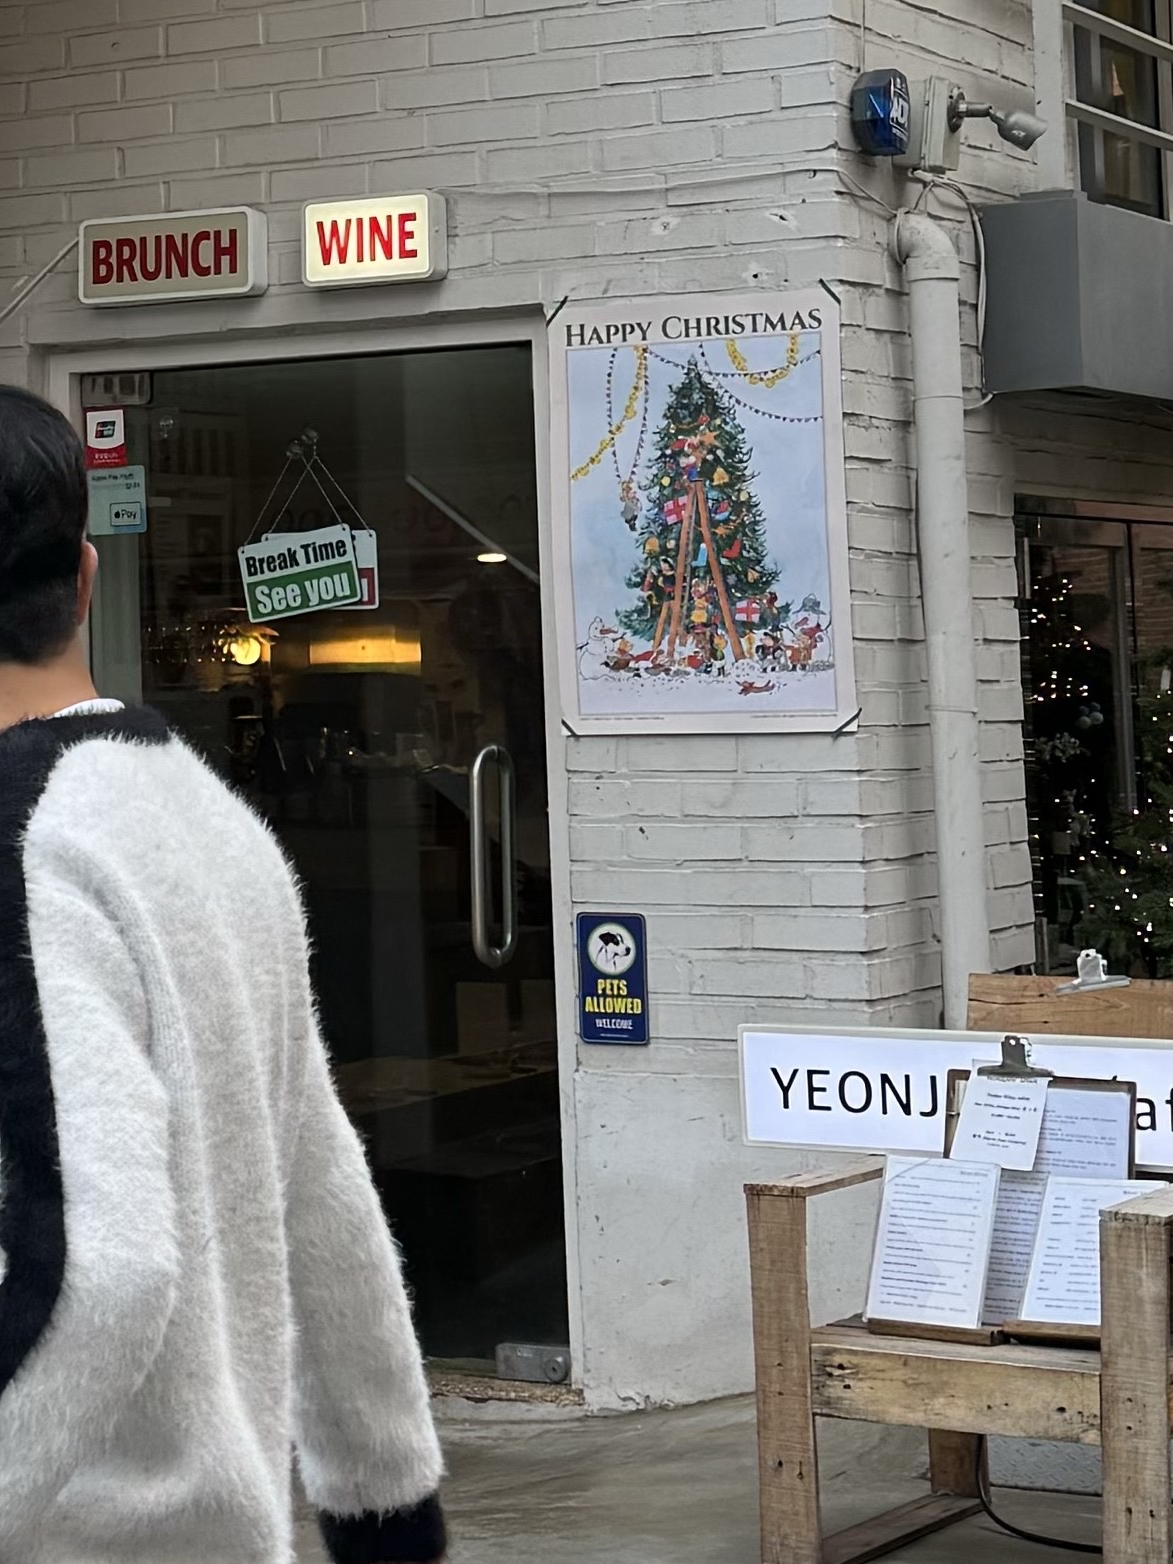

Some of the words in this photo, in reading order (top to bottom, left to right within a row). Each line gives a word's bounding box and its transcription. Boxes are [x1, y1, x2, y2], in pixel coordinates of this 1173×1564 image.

[92, 228, 238, 285] BRUNCH
[316, 212, 418, 266] WINE
[565, 321, 653, 347] HAPPY
[661, 308, 823, 339] CHRISTMAS
[245, 548, 300, 577] Break
[301, 539, 347, 565] Time
[255, 583, 301, 614] See
[304, 572, 351, 606] you
[585, 996, 642, 1014] ALLOWED
[597, 978, 628, 996] PETS
[595, 1018, 634, 1030] WELCOME
[769, 1066, 939, 1118] YEONJ
